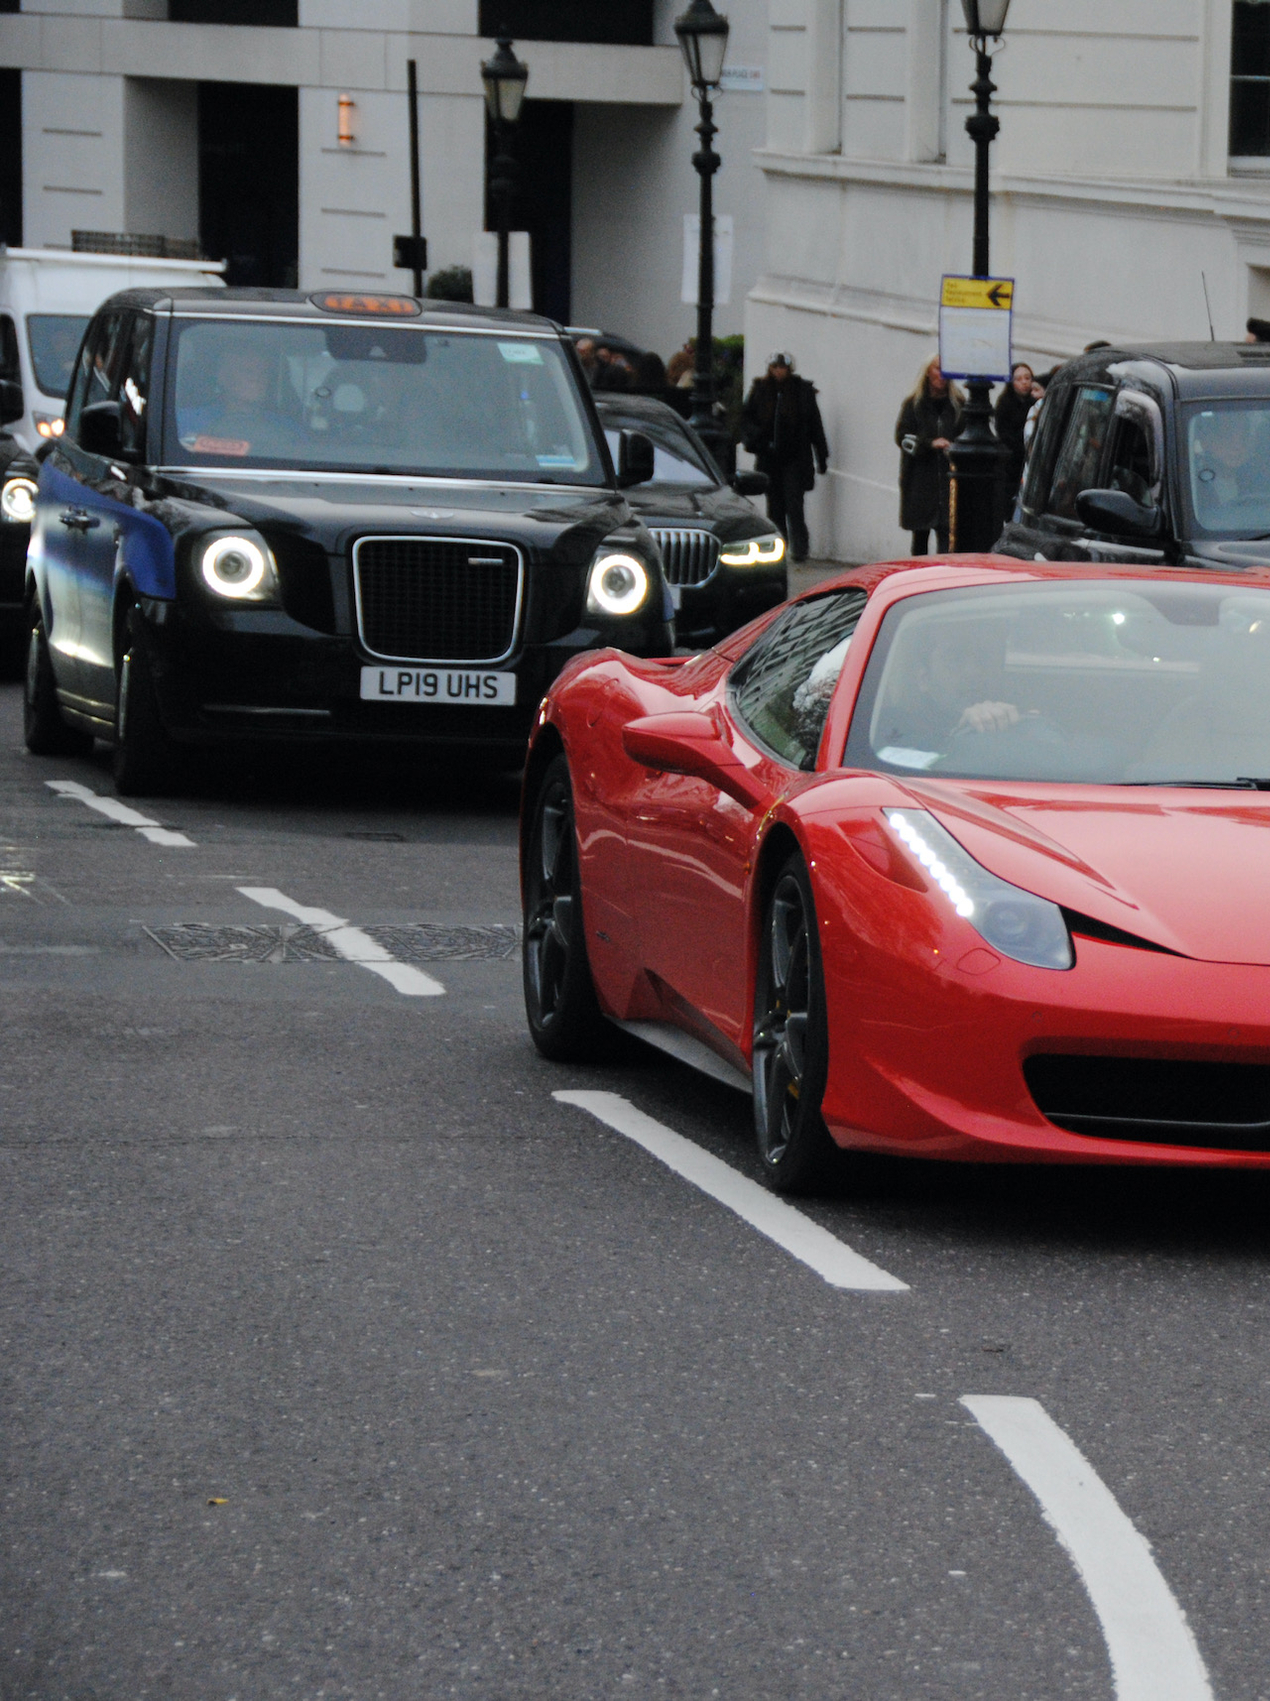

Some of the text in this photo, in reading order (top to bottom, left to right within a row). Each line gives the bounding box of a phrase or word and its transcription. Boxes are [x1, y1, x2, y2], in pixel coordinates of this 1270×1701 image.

[326, 294, 408, 313] TAXI
[379, 671, 498, 699] LP19 UHS
